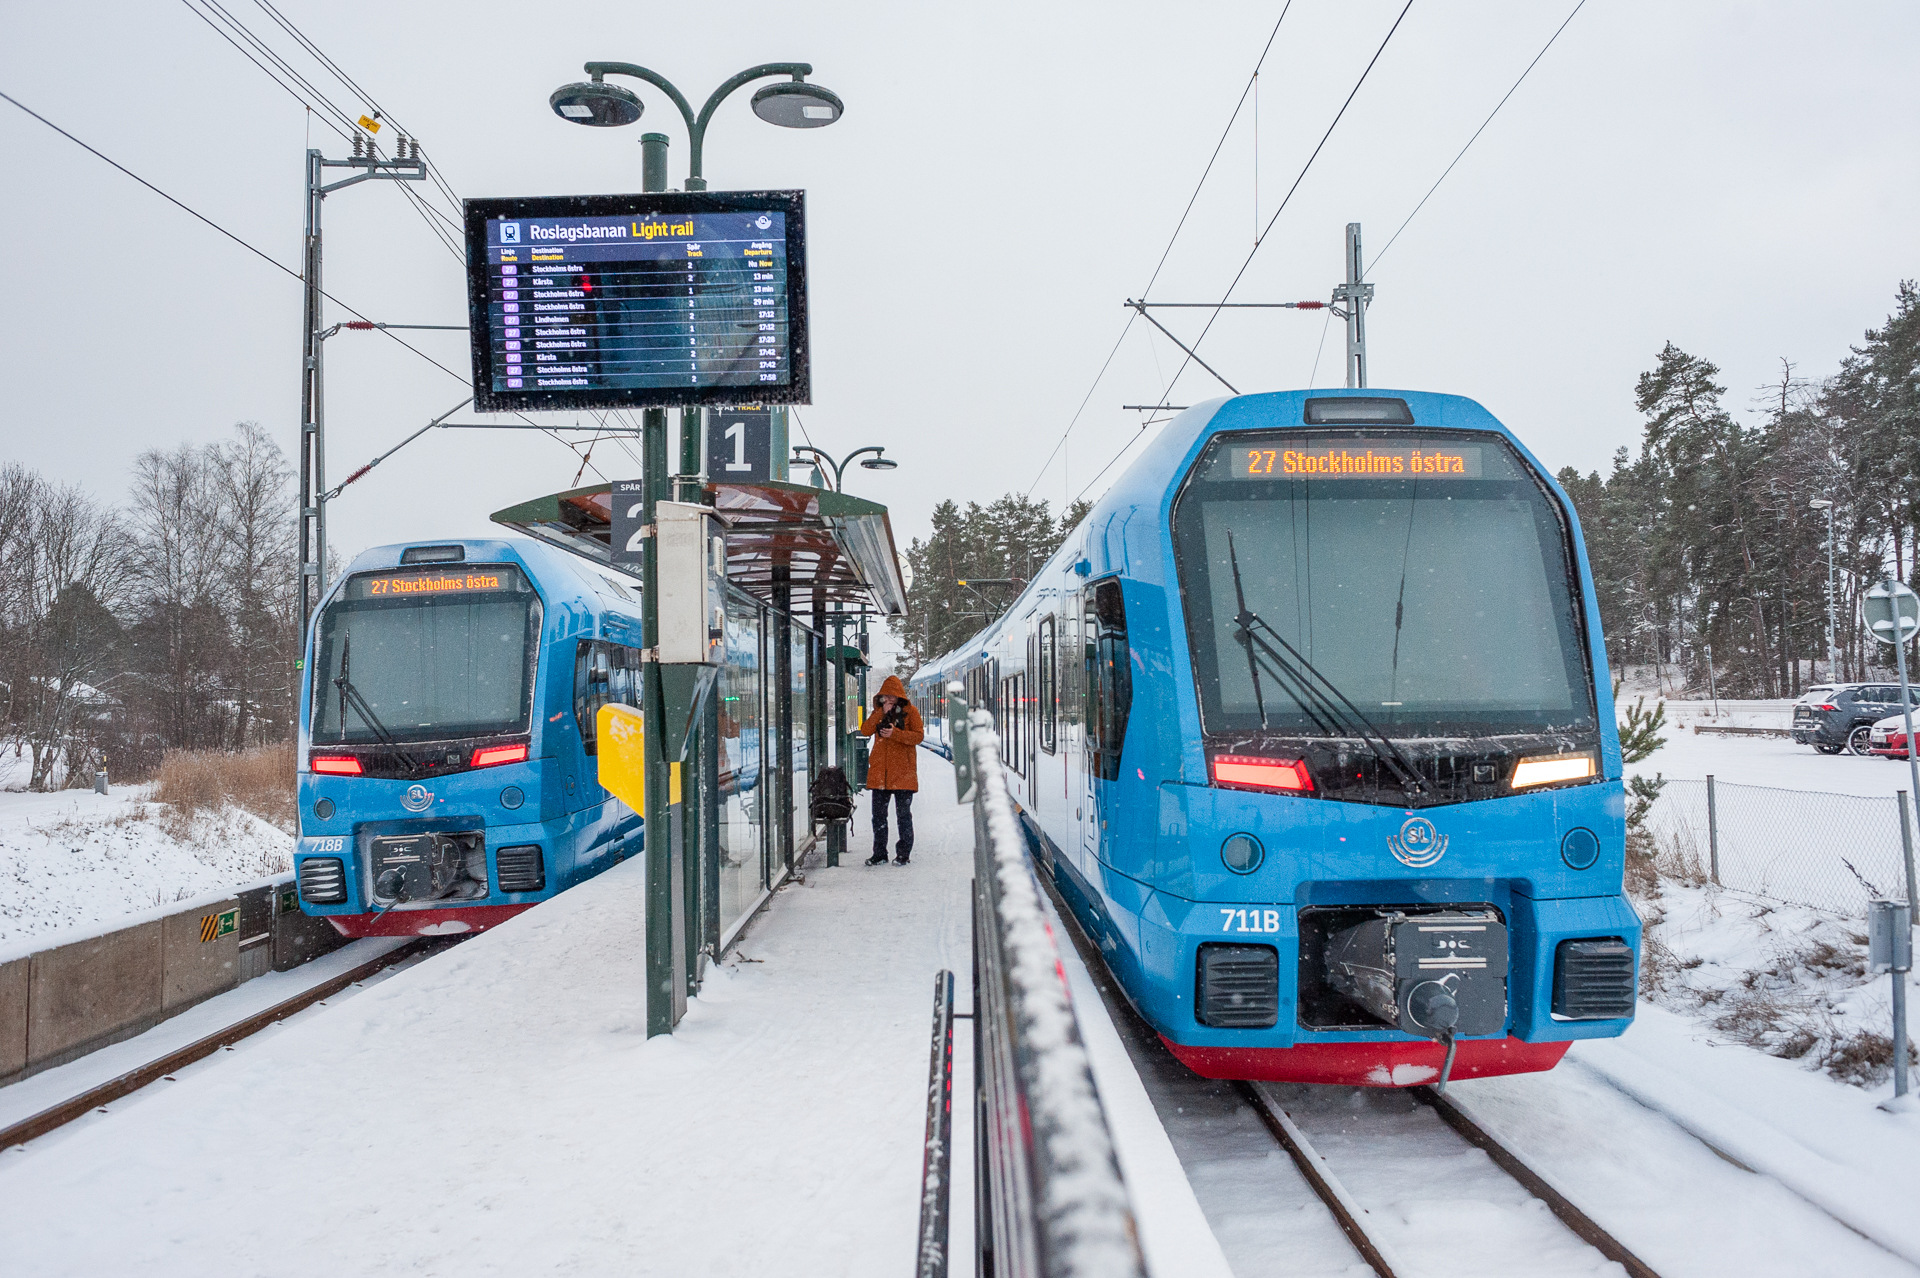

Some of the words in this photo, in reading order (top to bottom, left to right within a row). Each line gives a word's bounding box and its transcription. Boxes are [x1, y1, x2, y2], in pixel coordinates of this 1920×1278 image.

[530, 224, 626, 242] Roslagsbanan
[632, 222, 668, 239] Light
[670, 221, 694, 236] rail
[724, 422, 752, 471] 1
[1248, 451, 1276, 473] 27
[1283, 450, 1404, 473] Stockholms
[1410, 450, 1464, 473] östra
[620, 483, 640, 491] SPÅR
[626, 502, 643, 551] 2
[372, 580, 388, 594] 27
[392, 577, 463, 593] Stockholms
[466, 576, 498, 589] östra
[297, 660, 303, 668] 2
[1407, 826, 1429, 843] SL
[312, 839, 343, 852] 718B
[1220, 909, 1279, 933] 711B
